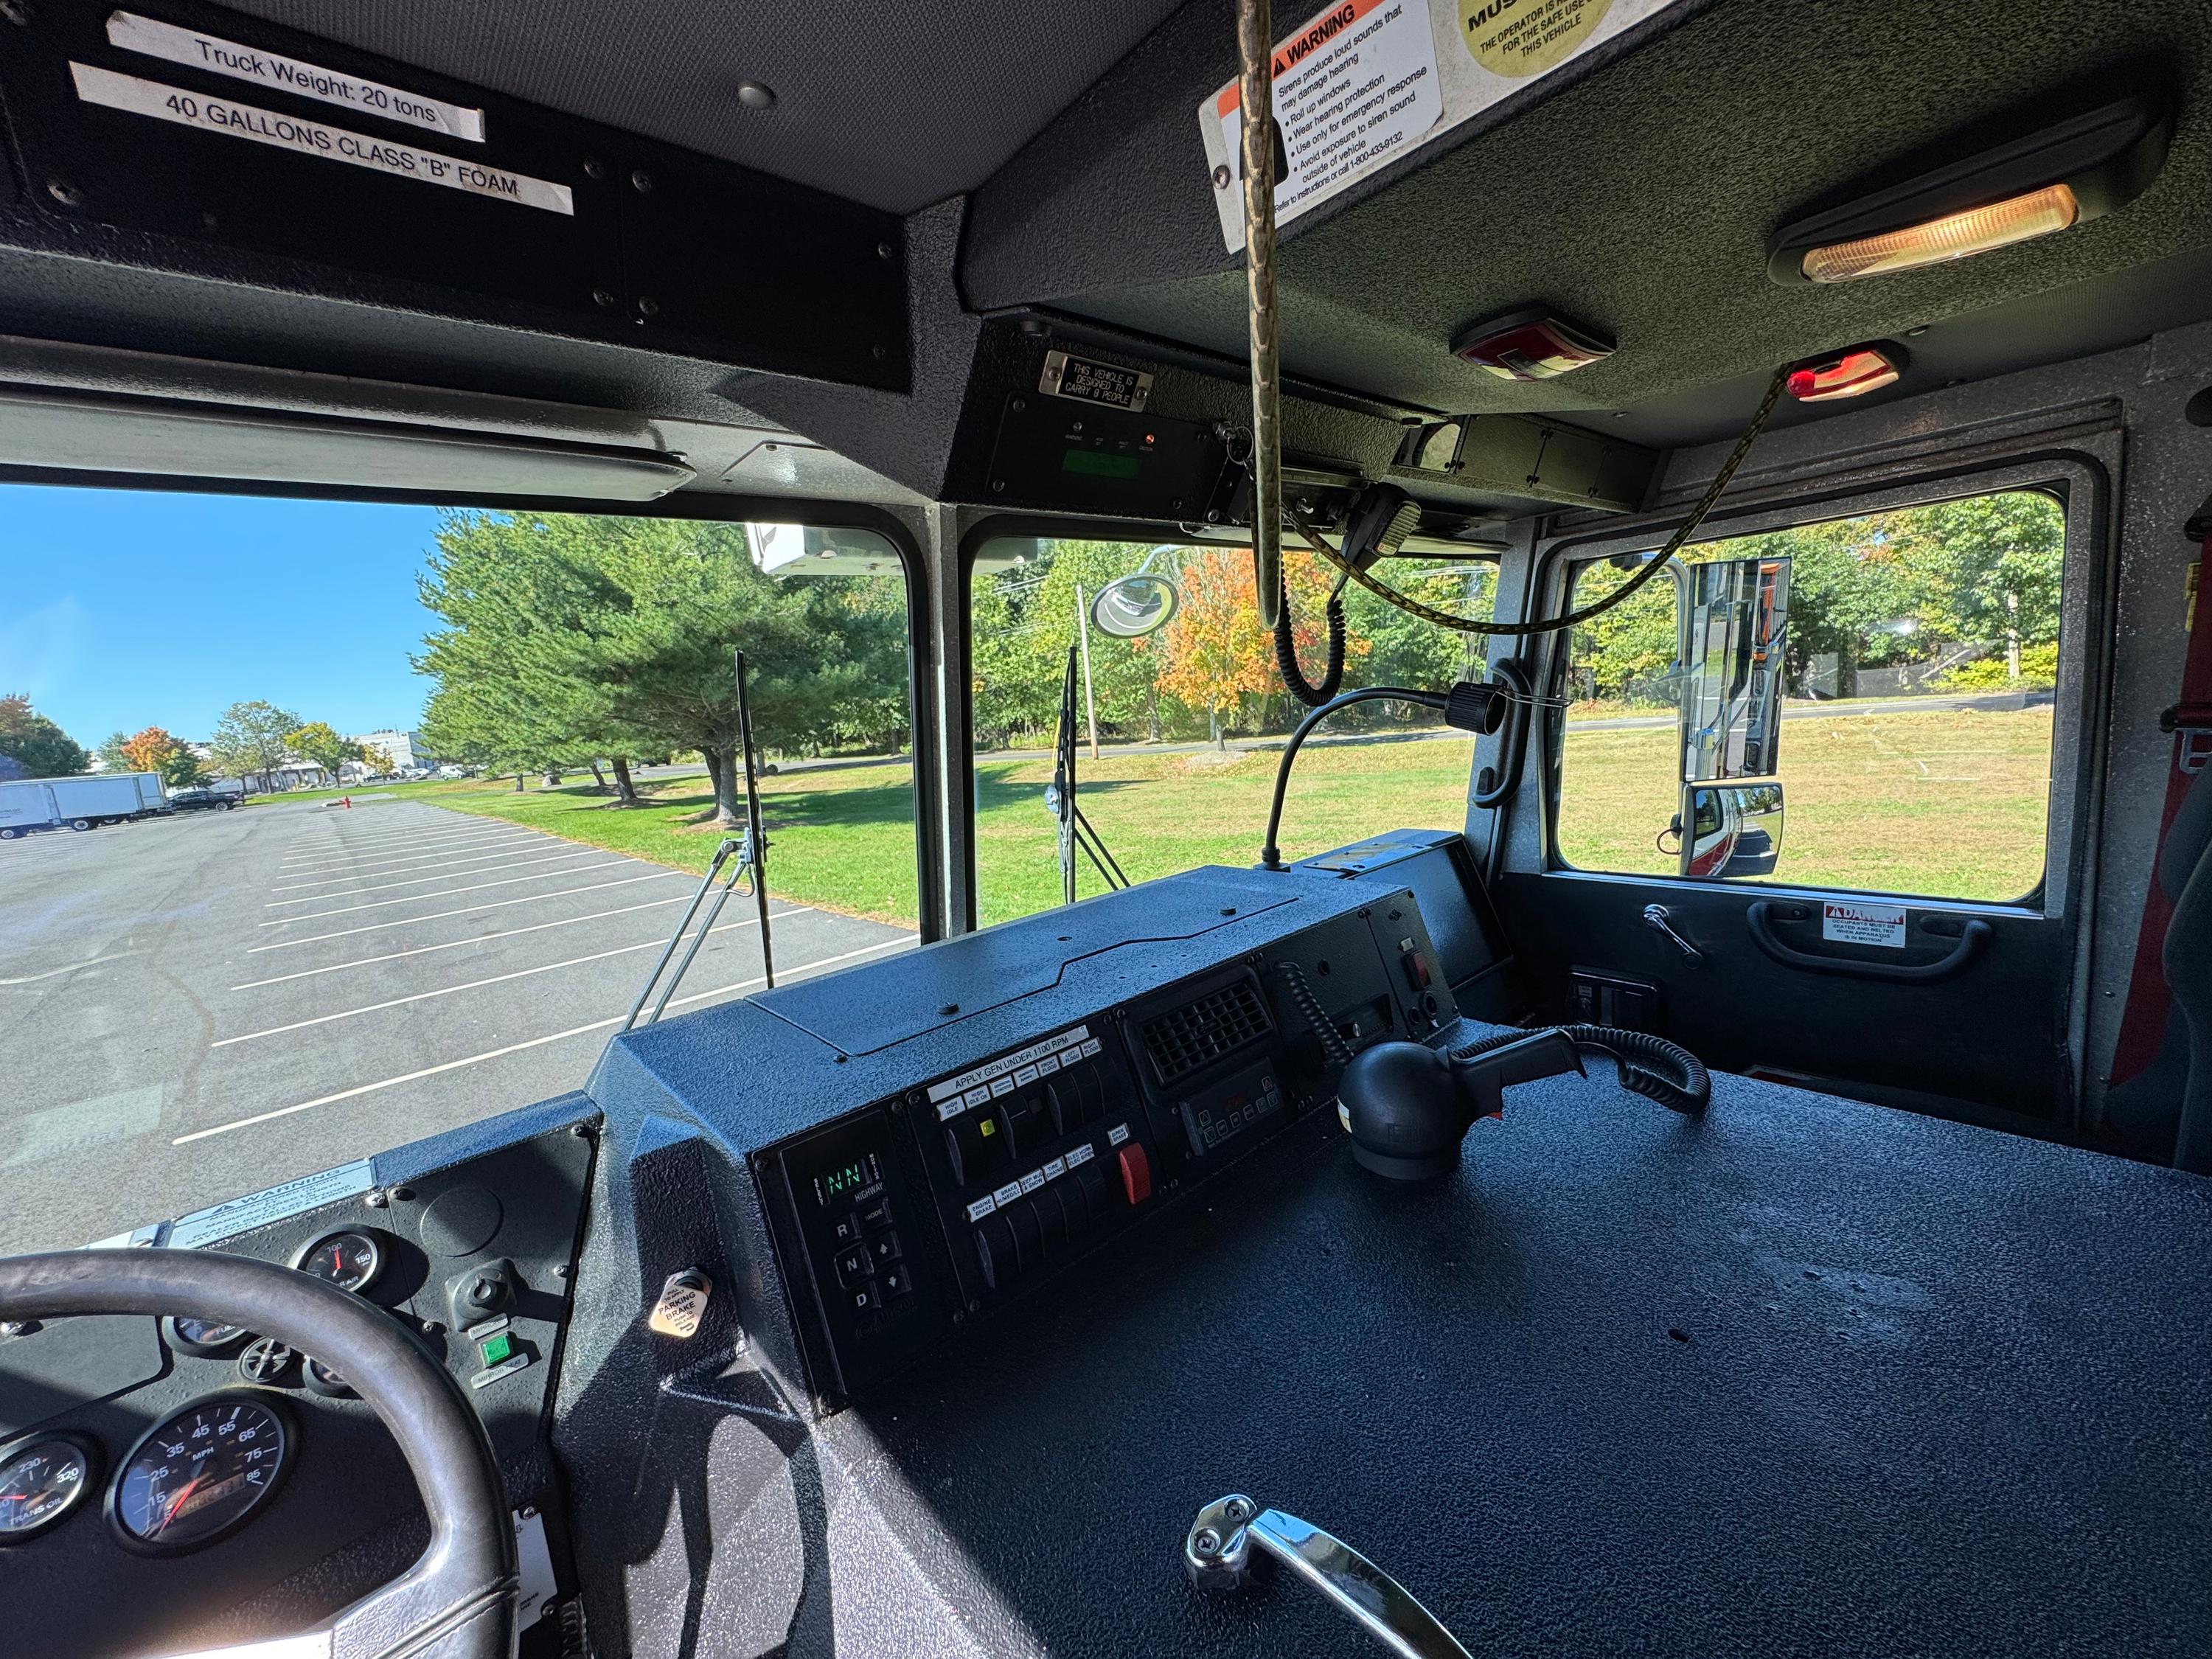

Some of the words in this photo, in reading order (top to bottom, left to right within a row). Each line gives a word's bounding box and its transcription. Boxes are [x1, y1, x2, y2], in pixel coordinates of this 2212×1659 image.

[1287, 4, 1354, 65] WARNING
[1480, 36, 1497, 53] THE
[1498, 7, 1543, 43] OPERATOR
[1545, 1, 1554, 13] IS
[1502, 38, 1520, 55] FOR
[1521, 26, 1539, 42] THE
[1541, 11, 1563, 31] SAFE
[1565, 0, 1585, 15] USE
[1520, 39, 1541, 57] THIS
[1543, 13, 1582, 44] VEHICLE
[1279, 77, 1301, 98] Sirens
[1303, 54, 1333, 84] produce
[1335, 41, 1352, 59] loud
[1353, 19, 1383, 46] sounds
[1385, 4, 1402, 23] that
[195, 39, 266, 77] Truck
[270, 60, 355, 100] Weight:
[361, 86, 388, 108] 20
[393, 96, 436, 122] tons
[1281, 97, 1297, 112] may
[1298, 75, 1328, 101] damage
[1329, 53, 1359, 80] hearing
[1290, 110, 1305, 125] Roll
[1306, 102, 1316, 114] up
[1318, 79, 1351, 105] windows
[1293, 120, 1313, 139] Wear
[1314, 102, 1343, 127] hearing
[1345, 74, 1385, 108] protection
[1295, 139, 1311, 155] Use
[1312, 128, 1328, 147] only
[1329, 121, 1340, 134] for
[1341, 91, 1385, 127] emergency
[1387, 66, 1427, 97] response
[1300, 153, 1321, 171] Avoid
[1321, 130, 1357, 159] exposure
[1357, 122, 1366, 133] to
[1367, 111, 1388, 129] siren
[1389, 91, 1416, 115] sound
[167, 94, 198, 118] 40
[206, 105, 331, 150] GALLONS
[338, 137, 414, 170] CLASS
[421, 156, 450, 177] "B"
[458, 166, 518, 195] FOAM
[1302, 163, 1328, 183] outside
[1330, 156, 1338, 167] of
[1339, 139, 1366, 161] vehicle
[1274, 199, 1290, 214] Refer
[1297, 176, 1330, 200] instructions
[1331, 172, 1338, 181] or
[1338, 162, 1349, 176] call
[1350, 131, 1403, 169] 1-800-433-9132
[1074, 363, 1091, 376] THIS
[1094, 366, 1124, 383] VEHICLE
[1126, 376, 1133, 386] IS
[1076, 375, 1111, 390] DESIGNED
[1116, 383, 1124, 393] TO
[1065, 383, 1091, 395] CARRY
[1093, 389, 1099, 397] 8
[1102, 391, 1130, 404] PEOPLE
[1832, 919, 1868, 927] OCCUPANTS
[1085, 1045, 1099, 1054] FLOOD
[956, 1071, 982, 1089] APPLY
[984, 1064, 1002, 1077] GEN
[1004, 1051, 1032, 1068] UNDER
[1034, 1043, 1051, 1056] 1100
[1051, 1035, 1068, 1049] RPM
[1040, 1059, 1057, 1068] FRONT
[1065, 1054, 1079, 1063] FLOOD
[1042, 1063, 1057, 1074] FLOOD
[968, 1096, 979, 1105] IDLE
[970, 1089, 984, 1098] HIGH
[945, 1101, 958, 1110] HIGH
[946, 1107, 959, 1116] IDLE
[1113, 1132, 1127, 1142] BRAKE
[1067, 1152, 1079, 1161] ELEC
[869, 1153, 880, 1180] MONITOR
[1047, 1166, 1062, 1178] CHAINS
[242, 1169, 341, 1203] WARNING
[1001, 1184, 1018, 1195] BRAKE
[1029, 1178, 1043, 1188] SNOW
[854, 1182, 884, 1203] HIGHWAY
[972, 1199, 991, 1211] ENGINE
[975, 1204, 993, 1217] BRAKE
[865, 1208, 883, 1221] MODE
[836, 1223, 848, 1237] R
[326, 1243, 342, 1253] 100
[355, 1253, 371, 1264] 150
[846, 1257, 858, 1272] N
[346, 1276, 358, 1285] AIR
[658, 1291, 696, 1315] PARKING
[856, 1293, 867, 1307] D
[666, 1301, 696, 1320] BRAKE
[478, 1368, 504, 1382] MIRROR
[192, 1424, 210, 1438] 45
[218, 1420, 236, 1435] 55
[238, 1427, 256, 1442] 65
[166, 1442, 184, 1458] 35
[192, 1447, 214, 1461] MPH
[244, 1447, 262, 1462] 75
[18, 1457, 41, 1473] 230
[57, 1467, 79, 1483] 320
[150, 1466, 169, 1482] 25
[246, 1469, 261, 1481] 85
[148, 1491, 166, 1506] 15
[10, 1505, 45, 1526] TRANS
[46, 1497, 63, 1509] OIL
